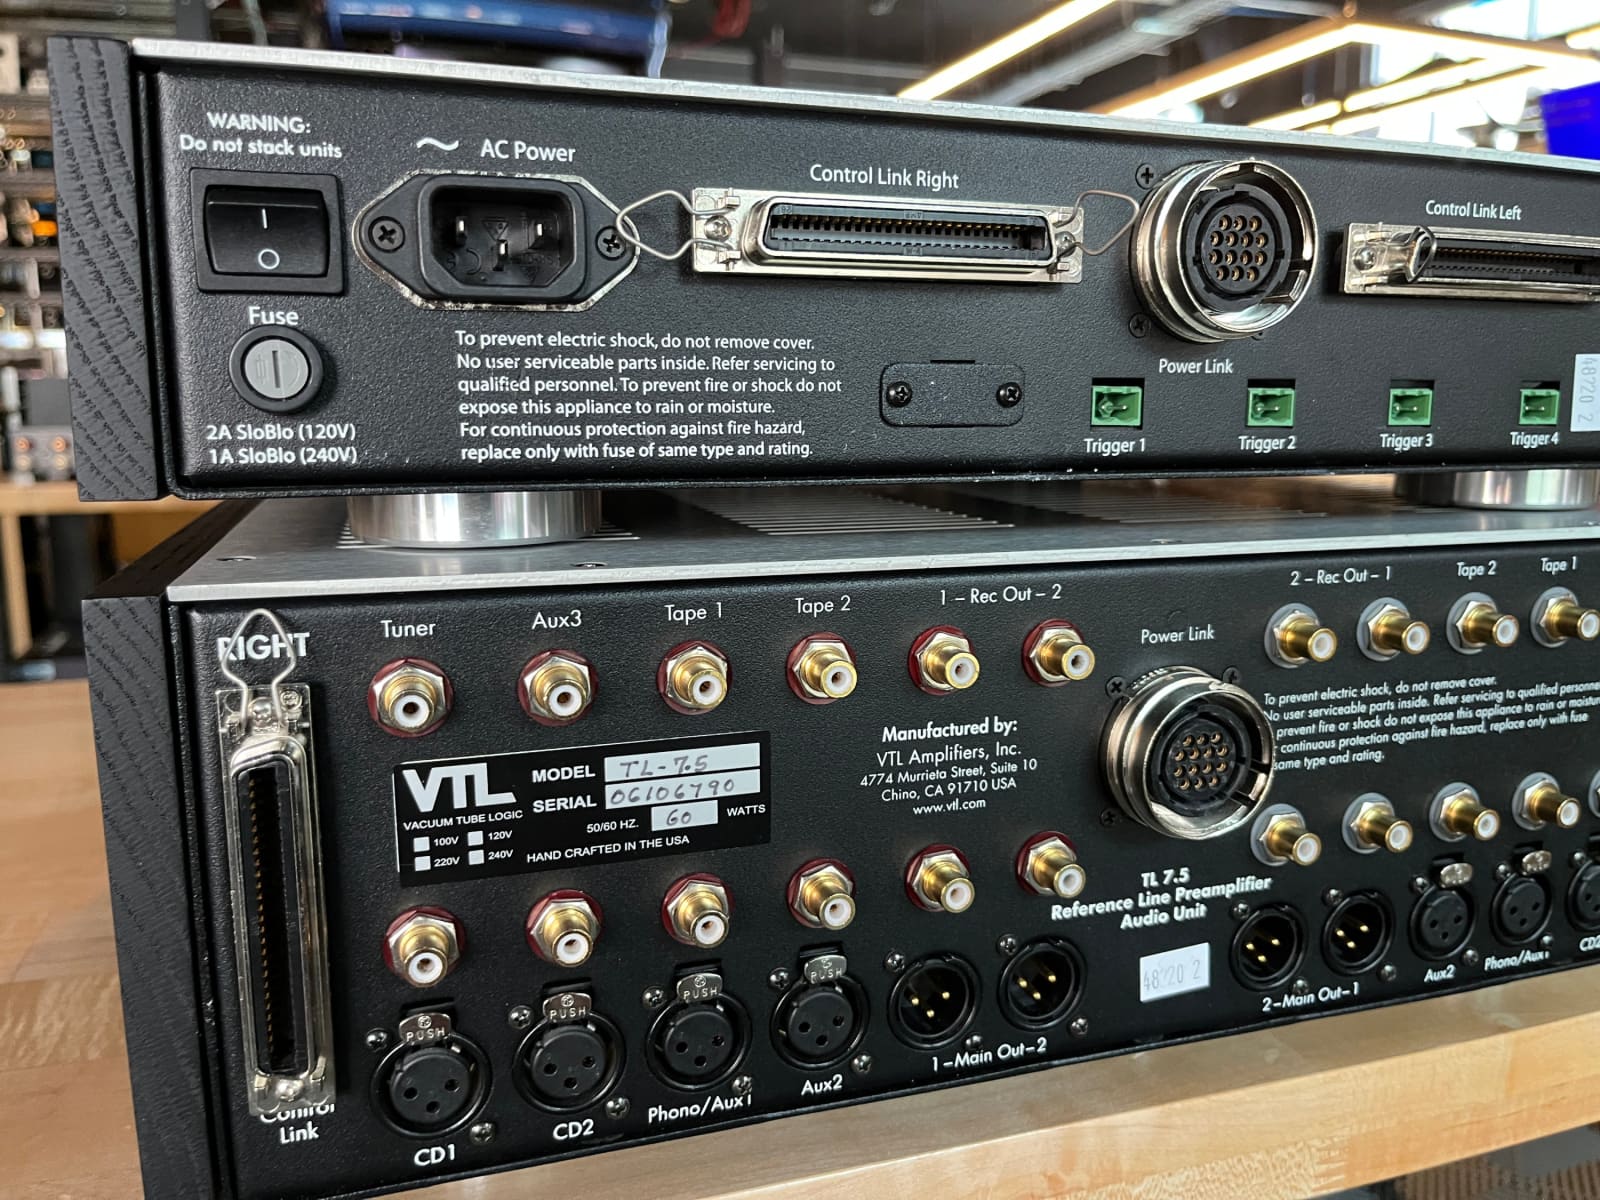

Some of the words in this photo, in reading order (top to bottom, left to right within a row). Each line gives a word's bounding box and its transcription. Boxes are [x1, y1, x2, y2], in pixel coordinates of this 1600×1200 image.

[206, 111, 311, 134] WARNING:
[178, 133, 208, 152] Do
[212, 137, 244, 153] not
[247, 137, 295, 156] stack
[298, 141, 343, 159] units
[480, 138, 510, 159] AC
[513, 140, 576, 163] Power
[809, 163, 873, 185] Control
[877, 167, 913, 186] Link
[916, 169, 960, 192] Right
[1425, 199, 1471, 217] Control
[1472, 202, 1498, 219] Link
[1498, 205, 1522, 221] Left
[248, 307, 299, 326] Fuse
[454, 329, 476, 346] To
[479, 333, 544, 350] prevent
[547, 330, 606, 347] electric
[609, 332, 659, 350] shock,
[660, 332, 682, 348] do
[685, 335, 711, 349] not
[714, 337, 770, 350] remove
[772, 338, 815, 350] cover.
[456, 353, 482, 369] No
[485, 357, 521, 370] user
[524, 353, 615, 370] serviceable
[618, 357, 658, 374] parts
[661, 354, 710, 371] inside.
[712, 355, 751, 371] Refer
[753, 356, 817, 375] servicing
[820, 358, 836, 371] to
[1158, 358, 1203, 374] Power
[1204, 358, 1234, 374] Link
[457, 375, 530, 396] qualified
[534, 376, 618, 396] personnel.
[619, 376, 639, 392] To
[642, 379, 702, 396] prevent
[703, 376, 729, 392] fire
[731, 381, 749, 392] or
[751, 377, 793, 393] shock
[795, 377, 815, 393] do
[818, 379, 842, 393] not
[458, 402, 518, 418] expose
[521, 398, 552, 415] this
[554, 398, 632, 418] appliance
[634, 400, 652, 414] to
[655, 399, 684, 414] rain
[687, 402, 705, 414] or
[707, 399, 776, 414] moisture.
[205, 423, 233, 441] 2A
[236, 423, 295, 442] SloBlo
[298, 422, 356, 442] (120V)
[459, 421, 488, 437] For
[490, 421, 582, 437] continuous
[585, 421, 667, 440] protection
[669, 420, 724, 439] against
[726, 419, 752, 435] fire
[754, 419, 806, 436] hazard,
[460, 443, 522, 464] replace
[524, 443, 561, 463] only
[563, 442, 599, 459] with
[601, 442, 636, 458] fuse
[638, 441, 656, 458] of
[657, 445, 698, 458] same
[699, 443, 735, 460] type
[736, 440, 765, 456] and
[768, 441, 814, 458] rating.
[1083, 437, 1136, 457] Trigger
[1139, 437, 1146, 452] 1
[1237, 435, 1287, 454] Trigger
[1286, 435, 1297, 450] 2
[1379, 433, 1425, 453] Trigger
[1424, 432, 1434, 448] 3
[208, 448, 235, 465] 1A
[237, 446, 297, 465] SloBlo
[299, 445, 358, 466] (240V)
[1456, 561, 1485, 580] Tape
[1487, 559, 1497, 576] 2
[1540, 557, 1568, 575] Tape
[1572, 555, 1577, 570] 1
[1316, 569, 1340, 585] Rec
[1343, 567, 1369, 583] Out
[970, 587, 998, 604] Rec
[1002, 585, 1033, 602] Out
[663, 604, 708, 625] Tape
[715, 601, 722, 619] 1
[794, 597, 834, 618] Tape
[840, 594, 851, 612] 2
[380, 619, 437, 638] Tuner
[531, 609, 582, 630] Aux3
[1141, 628, 1185, 645] Power
[1188, 623, 1215, 642] Link
[217, 632, 310, 660] RIGHT
[1263, 692, 1277, 706] To
[1278, 690, 1319, 708] prevent
[1320, 686, 1358, 701] electric
[1359, 681, 1392, 697] shock,
[1395, 680, 1410, 694] do
[1411, 680, 1429, 692] not
[1430, 679, 1467, 690] remove
[1468, 676, 1497, 688] cover.
[881, 718, 990, 743] Manufactured
[993, 715, 1018, 737] by:
[876, 750, 904, 767] VTL
[908, 743, 990, 765] Amplifiers,
[995, 741, 1022, 757] Inc.
[532, 764, 595, 784] MODEL
[860, 772, 894, 787] 4774
[897, 764, 947, 784] Murrieta
[950, 764, 986, 778] Street,
[990, 761, 1018, 775] Suite
[1023, 758, 1038, 771] 10
[403, 762, 517, 813] VTL
[881, 788, 921, 802] Chino,
[924, 784, 945, 798] CA
[947, 779, 989, 795] 91710
[991, 776, 1017, 791] USA
[532, 795, 597, 814] SERIAL
[726, 803, 766, 817] WATTS
[912, 798, 986, 815] www.vtl.com
[402, 817, 454, 831] VACUUM
[455, 813, 487, 825] TUBE
[488, 809, 524, 822] LOGIC
[586, 820, 617, 834] 50/60
[620, 818, 640, 830] HZ.
[666, 809, 693, 826] 60
[433, 835, 459, 847] 100V
[487, 829, 513, 841] 120V
[487, 849, 513, 861] 240V
[526, 850, 562, 863] HAND
[564, 842, 622, 859] CRAFTED
[624, 840, 637, 851] IN
[638, 837, 663, 849] THE
[665, 835, 690, 847] USA
[433, 855, 460, 868] 220V
[1140, 871, 1159, 888] TL
[1162, 867, 1190, 885] 7.5
[1051, 897, 1134, 921] Reference
[1137, 890, 1172, 908] Line
[1175, 875, 1272, 902] Preamplifier
[1120, 910, 1170, 930] Audio
[1173, 902, 1207, 920] Unit
[1424, 964, 1456, 983] Aux2
[683, 987, 719, 1001] PUSH
[549, 1006, 587, 1021] PUSH
[406, 1024, 446, 1042] PUSH
[801, 1074, 843, 1096] Aux2
[553, 1119, 594, 1141] CD2
[414, 1144, 456, 1167] CD1
